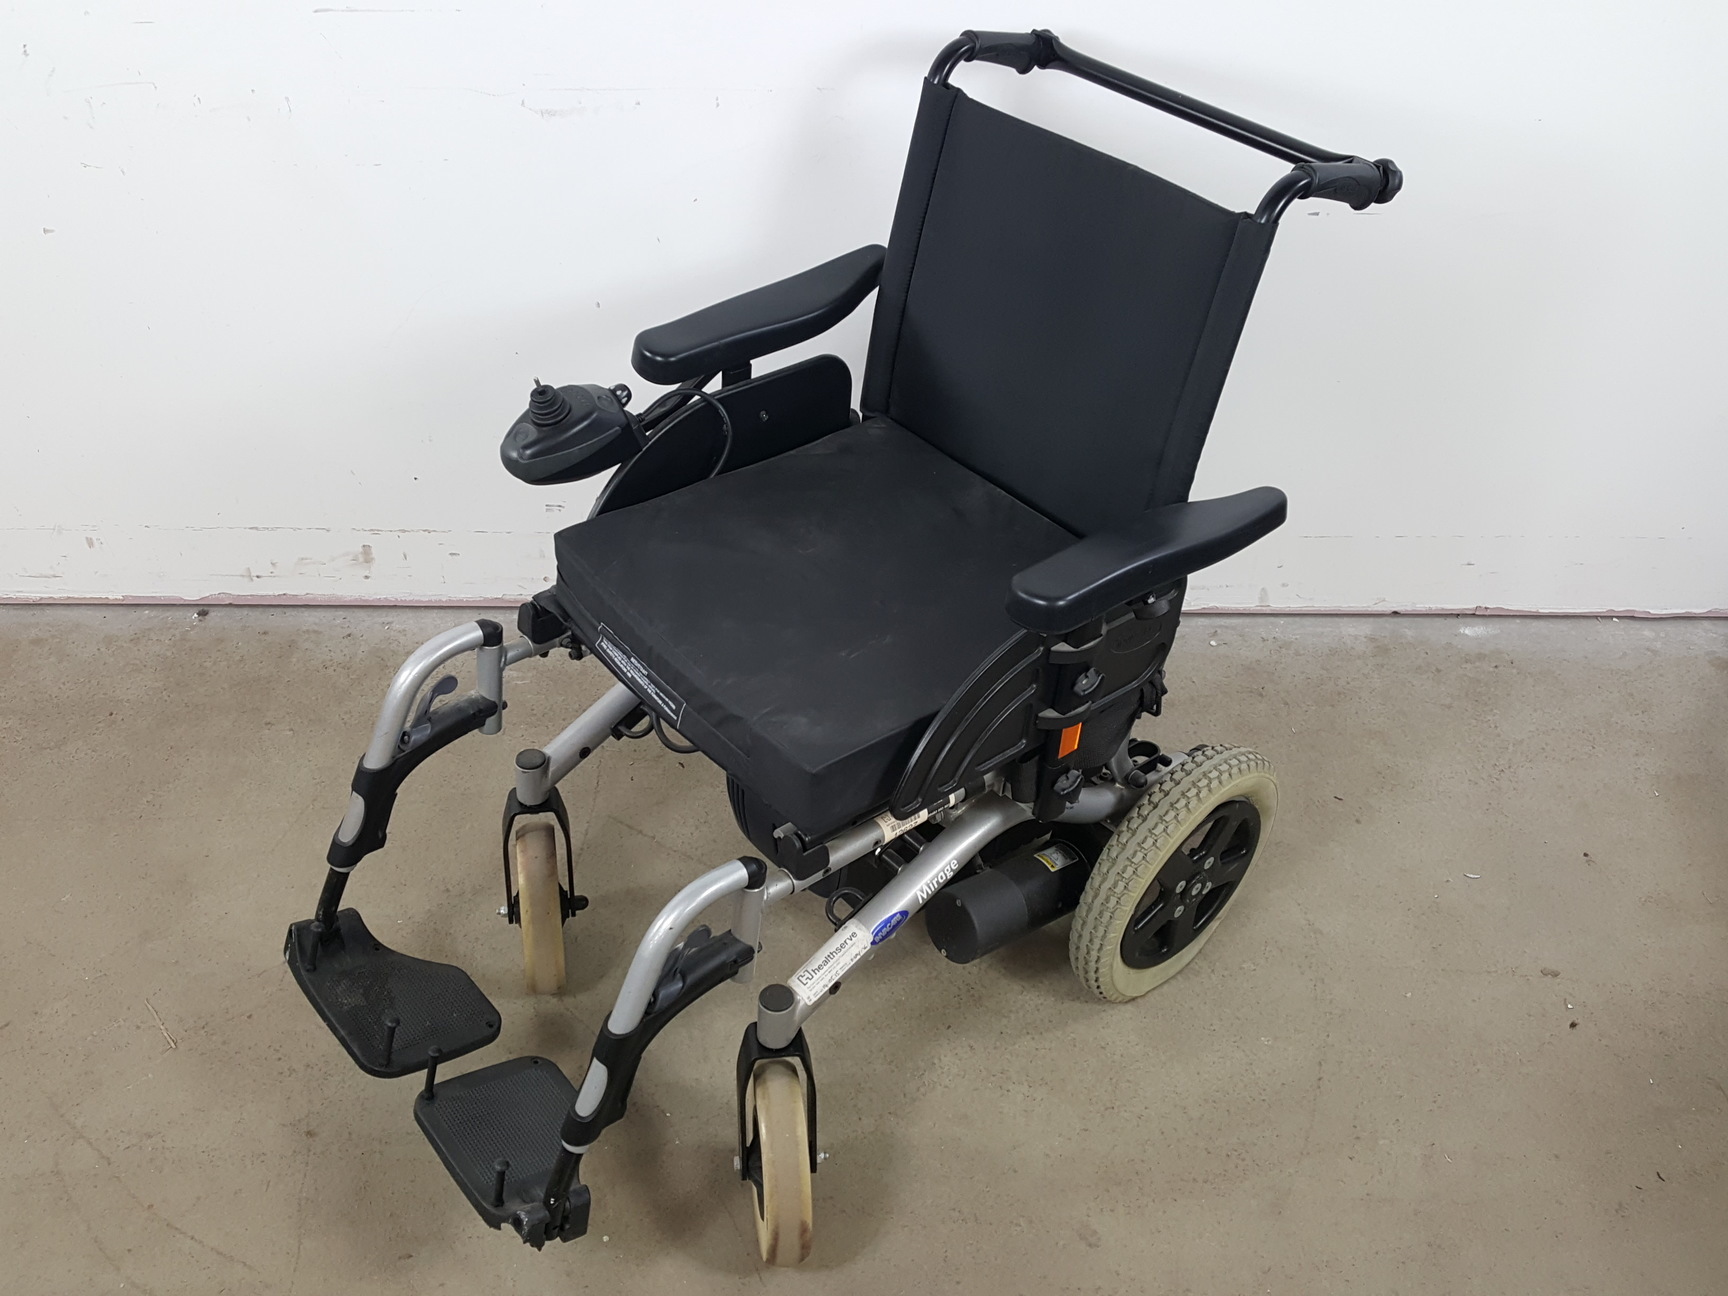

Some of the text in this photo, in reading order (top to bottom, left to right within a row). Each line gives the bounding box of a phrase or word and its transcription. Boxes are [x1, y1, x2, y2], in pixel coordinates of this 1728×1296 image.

[916, 859, 958, 904] Mirage
[874, 912, 903, 943] INVACARE
[811, 931, 858, 976] healthserve
